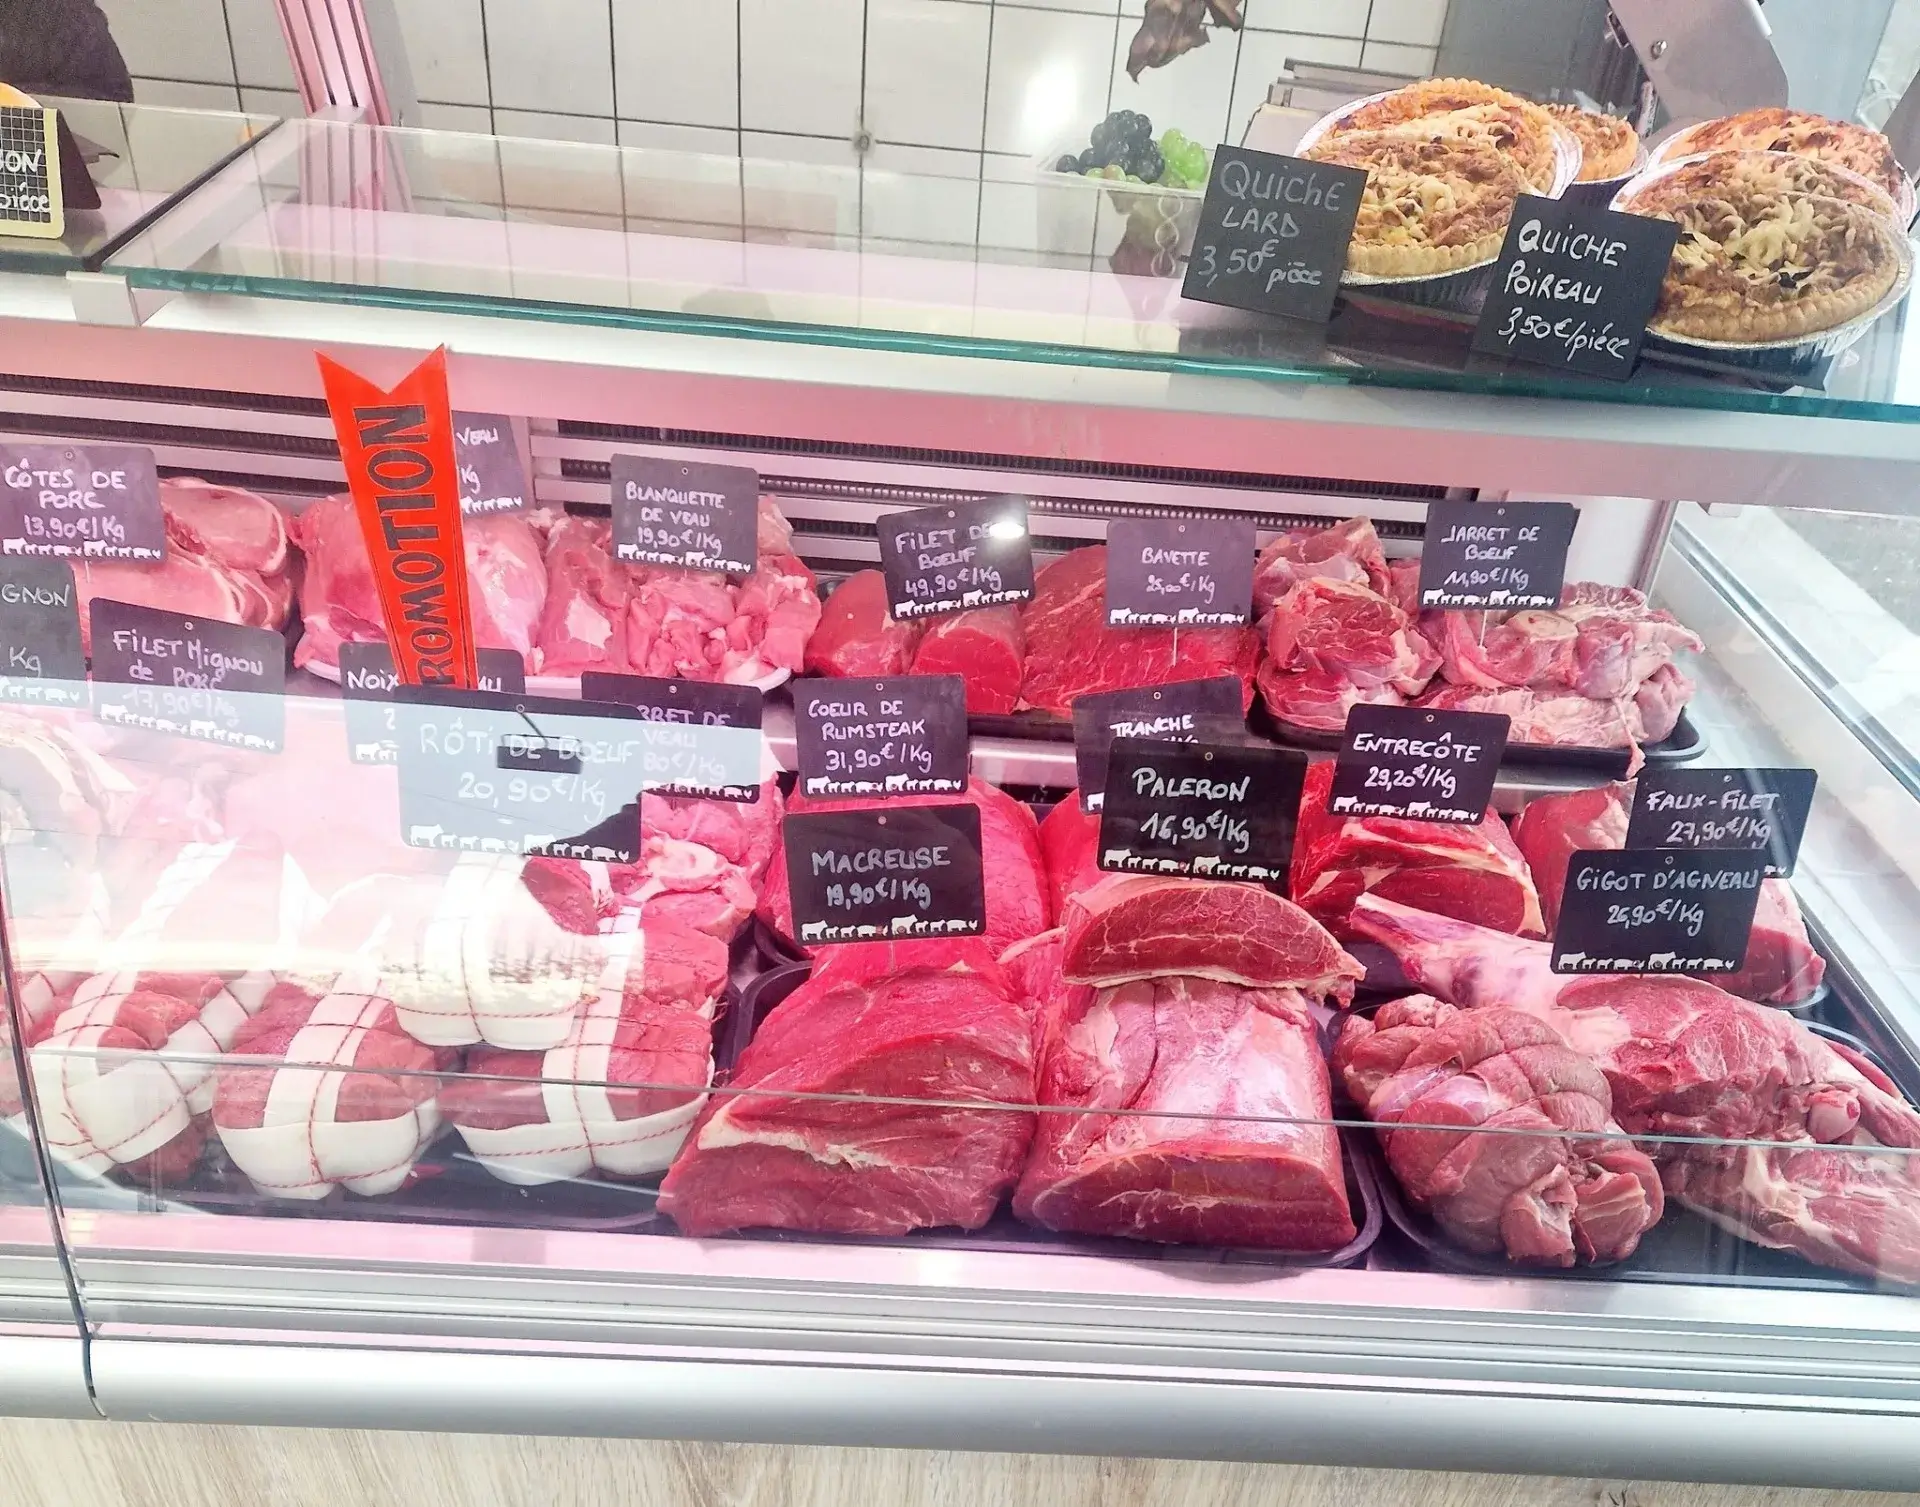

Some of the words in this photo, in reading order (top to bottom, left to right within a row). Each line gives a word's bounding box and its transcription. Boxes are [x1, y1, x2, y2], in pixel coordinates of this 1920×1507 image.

[0, 149, 42, 173] ON
[1221, 206, 1300, 237] LARD
[4, 458, 75, 489] CÔTES
[91, 470, 127, 490] DE
[39, 490, 106, 510] PORC
[626, 480, 727, 509] BLANQUETTE
[641, 507, 663, 522] DE
[669, 510, 710, 527] VEAU
[353, 404, 457, 687] ROMOTION
[1441, 525, 1511, 543] JARRET
[1518, 526, 1541, 542] DE
[1141, 547, 1211, 567] BAVETTE
[1, 584, 70, 608] GNON
[808, 699, 869, 718] COEUR
[880, 700, 904, 715] DE
[821, 719, 926, 741] RUMSTEAK
[1109, 714, 1196, 738] TRANCHE
[509, 735, 543, 760] DE
[1353, 732, 1482, 763] ENTRECÔTE
[1132, 767, 1251, 803] PALERON
[811, 847, 951, 877] MACREUSE
[1653, 869, 1759, 890] D'AGNEAU
